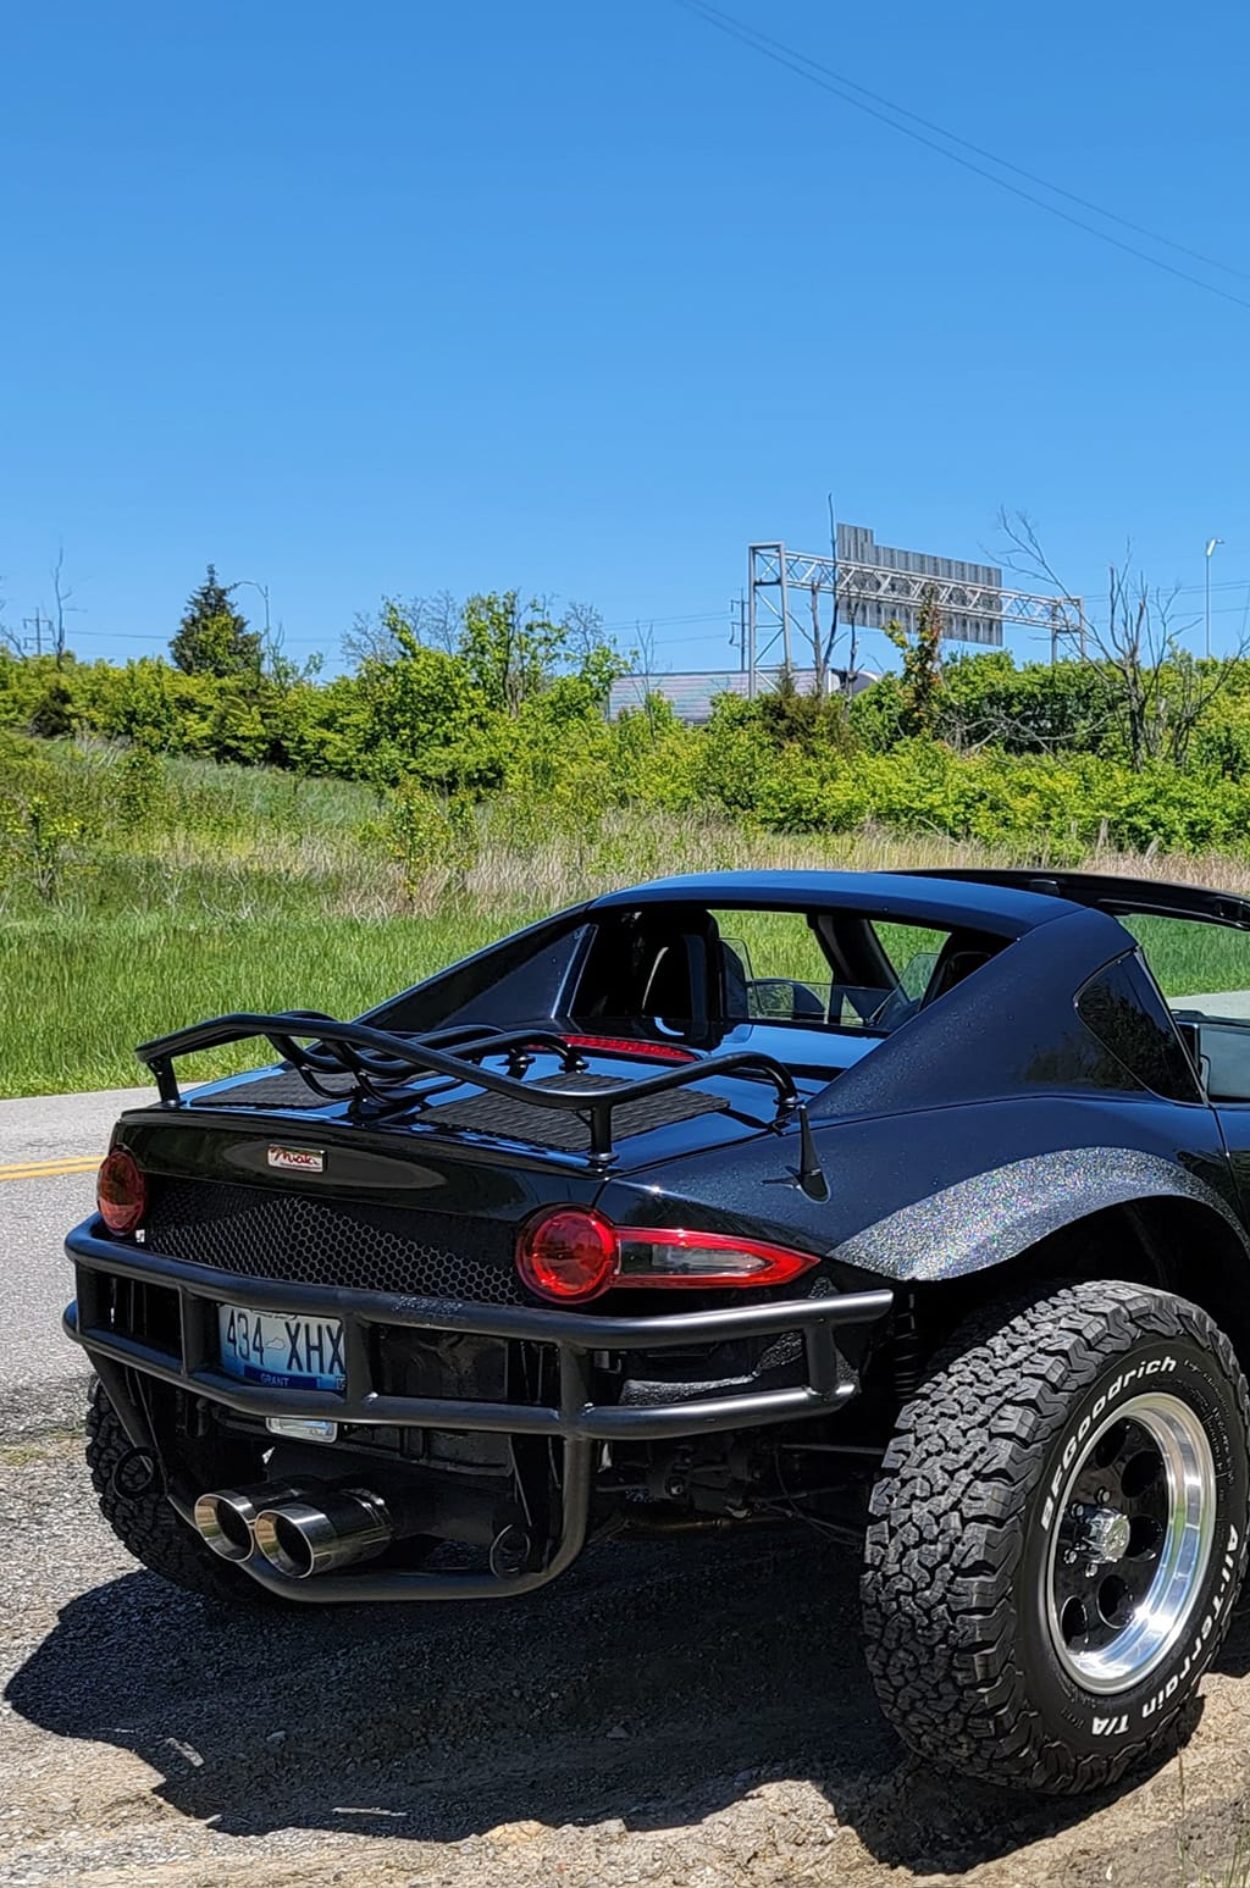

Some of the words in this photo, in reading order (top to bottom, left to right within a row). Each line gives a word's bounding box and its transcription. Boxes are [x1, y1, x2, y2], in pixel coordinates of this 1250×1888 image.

[227, 1308, 264, 1366] 434
[285, 1321, 346, 1375] XHX
[1091, 1714, 1129, 1736] T/A
